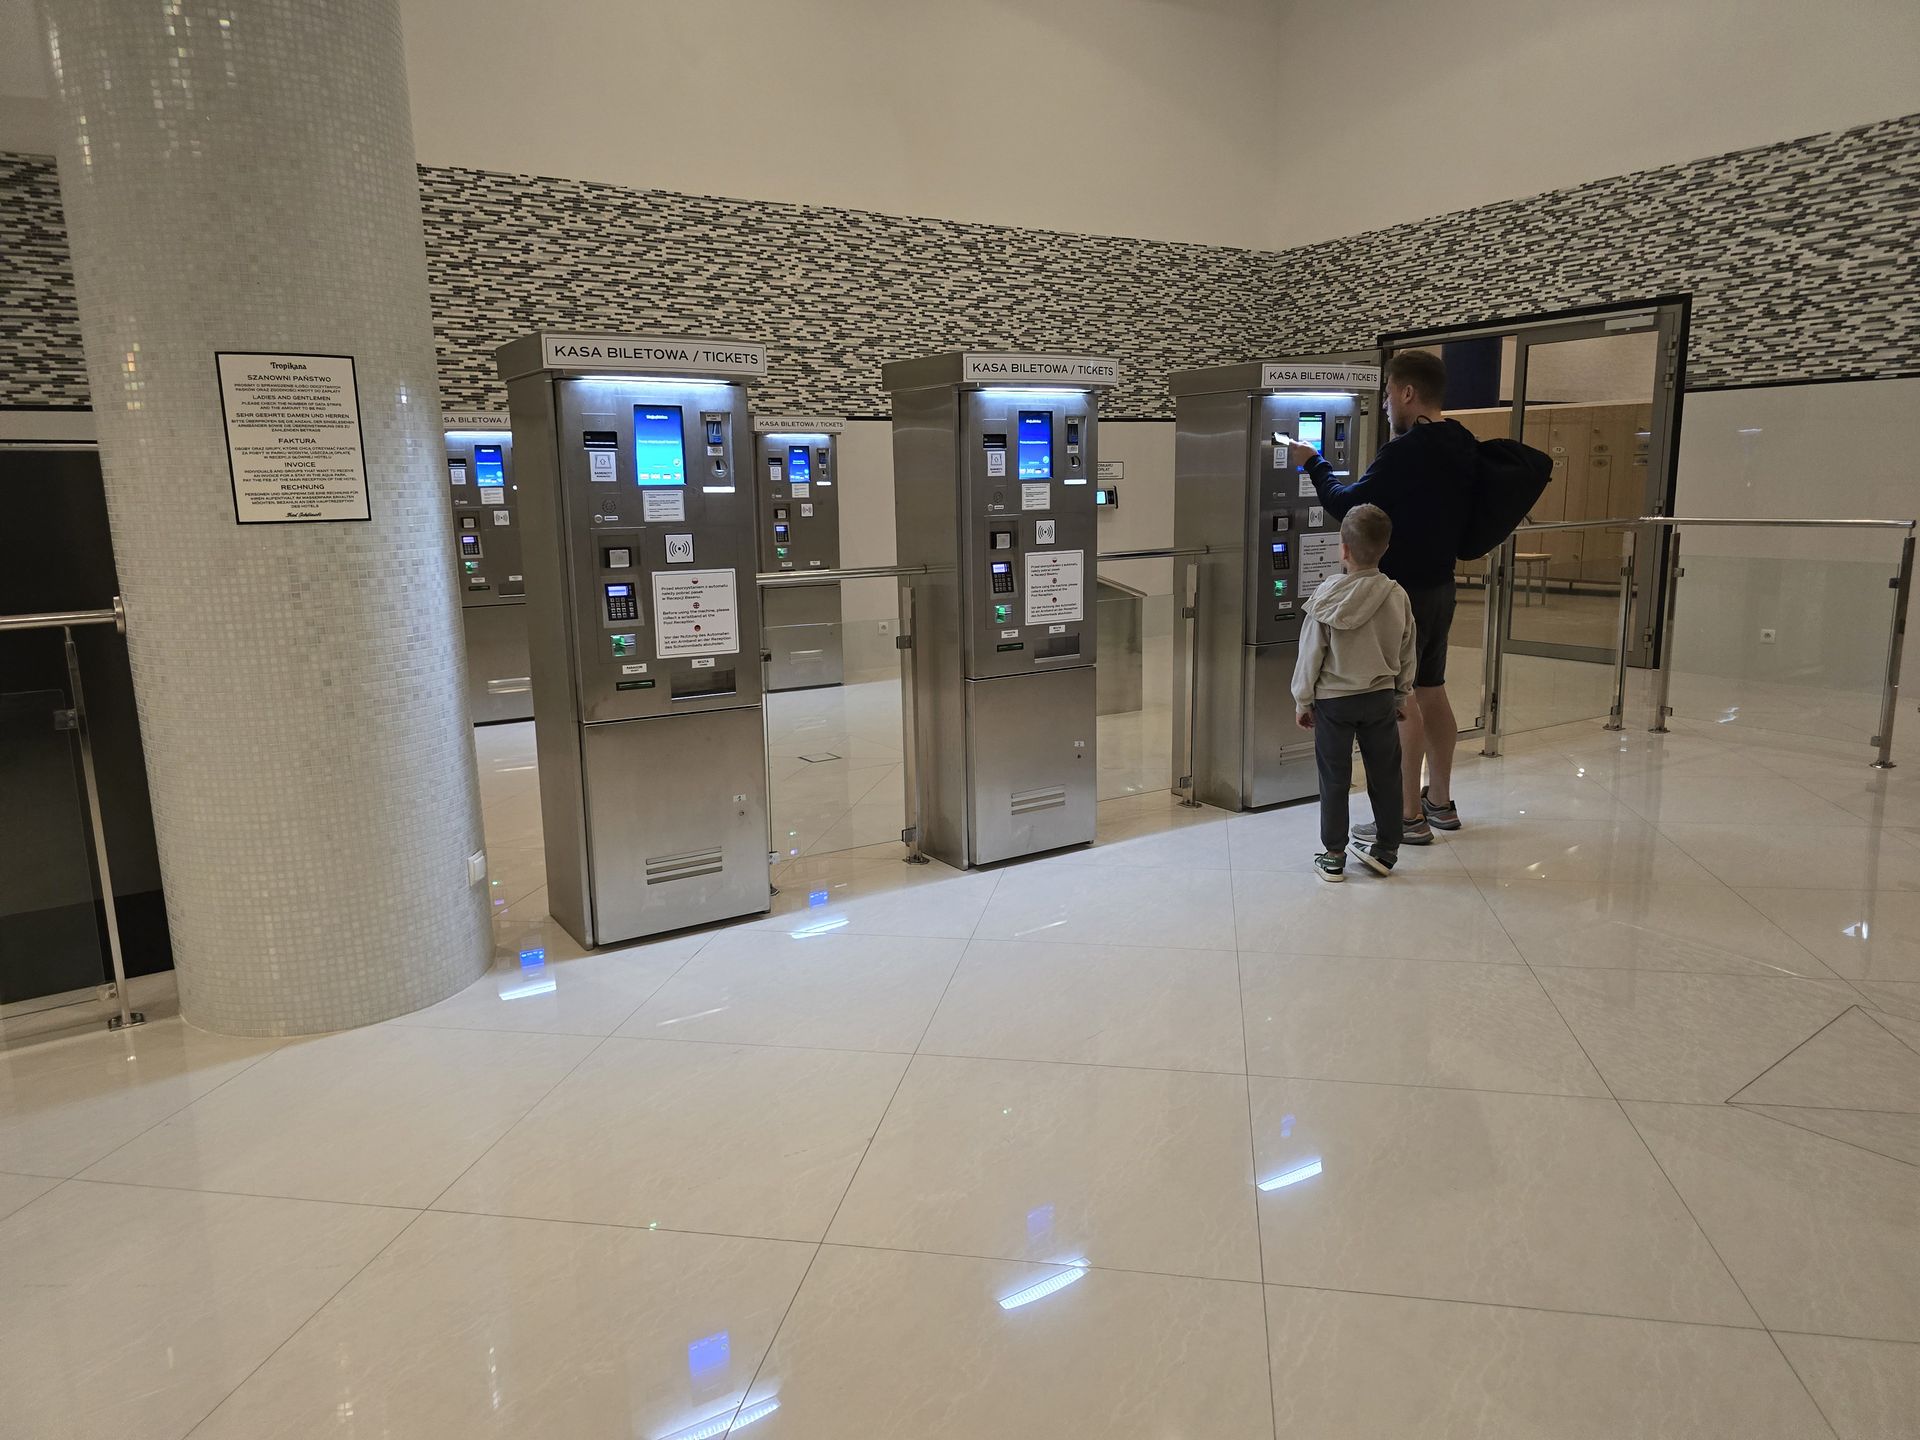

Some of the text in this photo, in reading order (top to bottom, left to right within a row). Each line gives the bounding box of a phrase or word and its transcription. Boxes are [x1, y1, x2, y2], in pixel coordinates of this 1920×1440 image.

[555, 346, 758, 364] KASA BILETOWA / TICKETS
[270, 362, 307, 370] Tropikana
[972, 363, 1113, 376] KASA BILETOWA / TICKETS
[1269, 372, 1298, 380] KASA
[1300, 372, 1344, 380] BILETOWA
[1352, 373, 1377, 382] TICKETS
